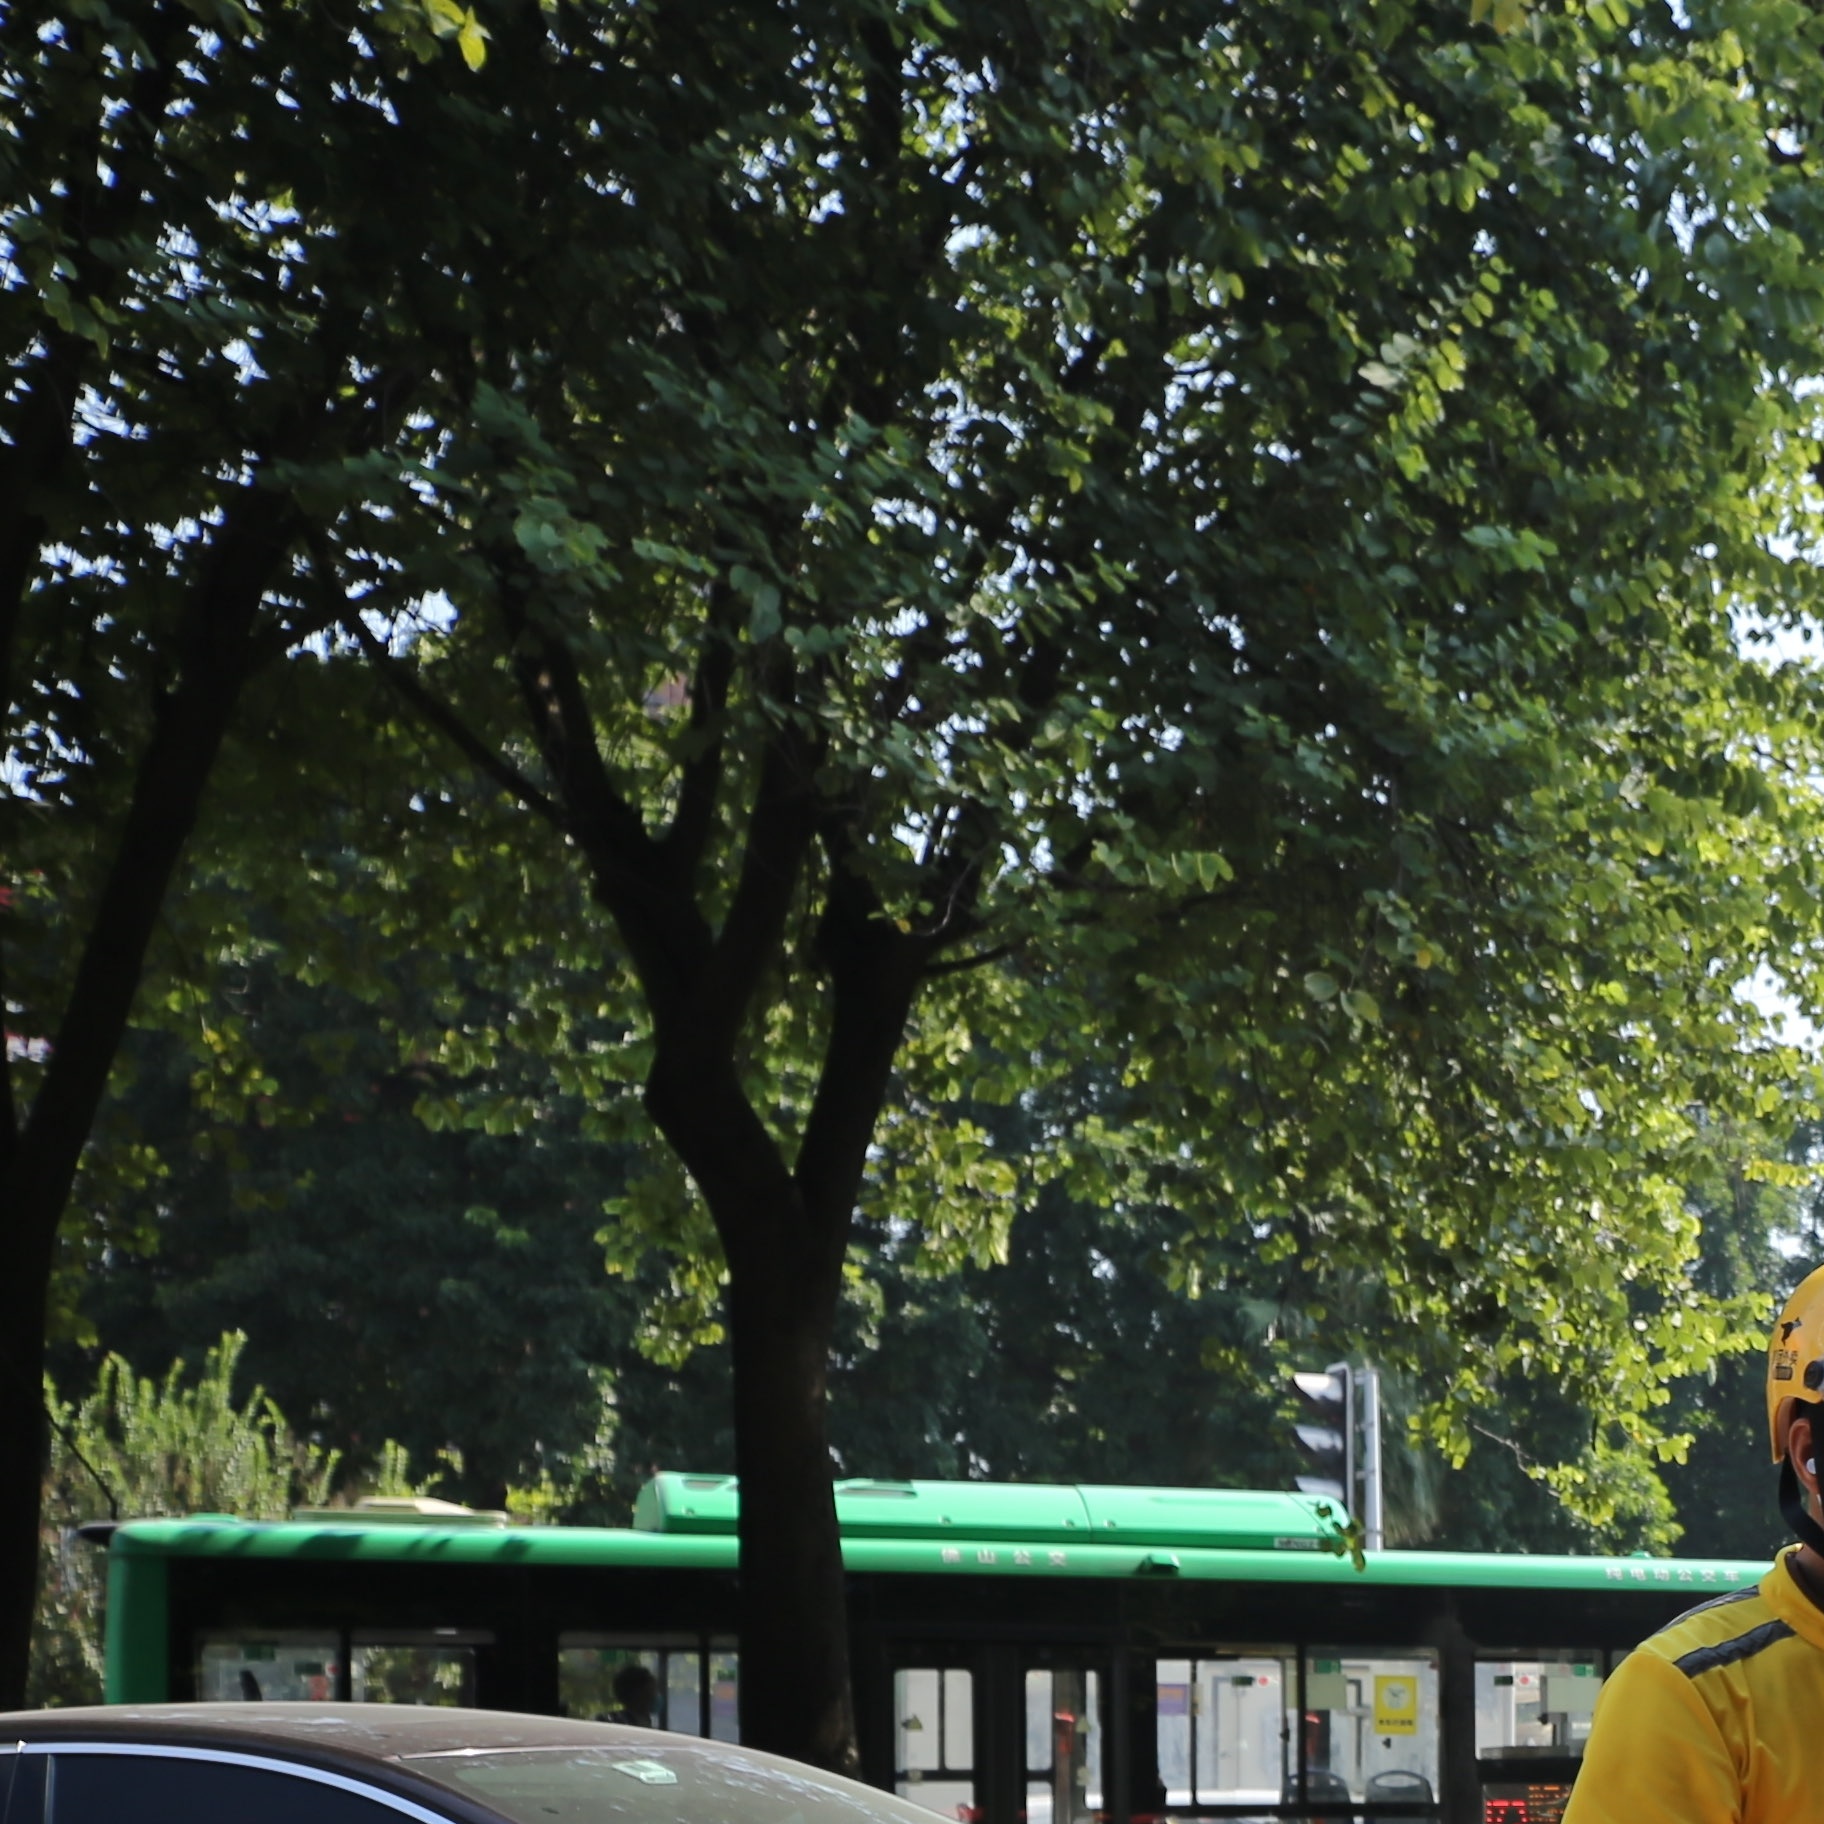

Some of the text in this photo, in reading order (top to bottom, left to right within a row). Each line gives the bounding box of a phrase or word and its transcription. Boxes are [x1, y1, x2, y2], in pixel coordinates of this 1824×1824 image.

[1605, 1566, 1740, 1583] 纯电动公交车
